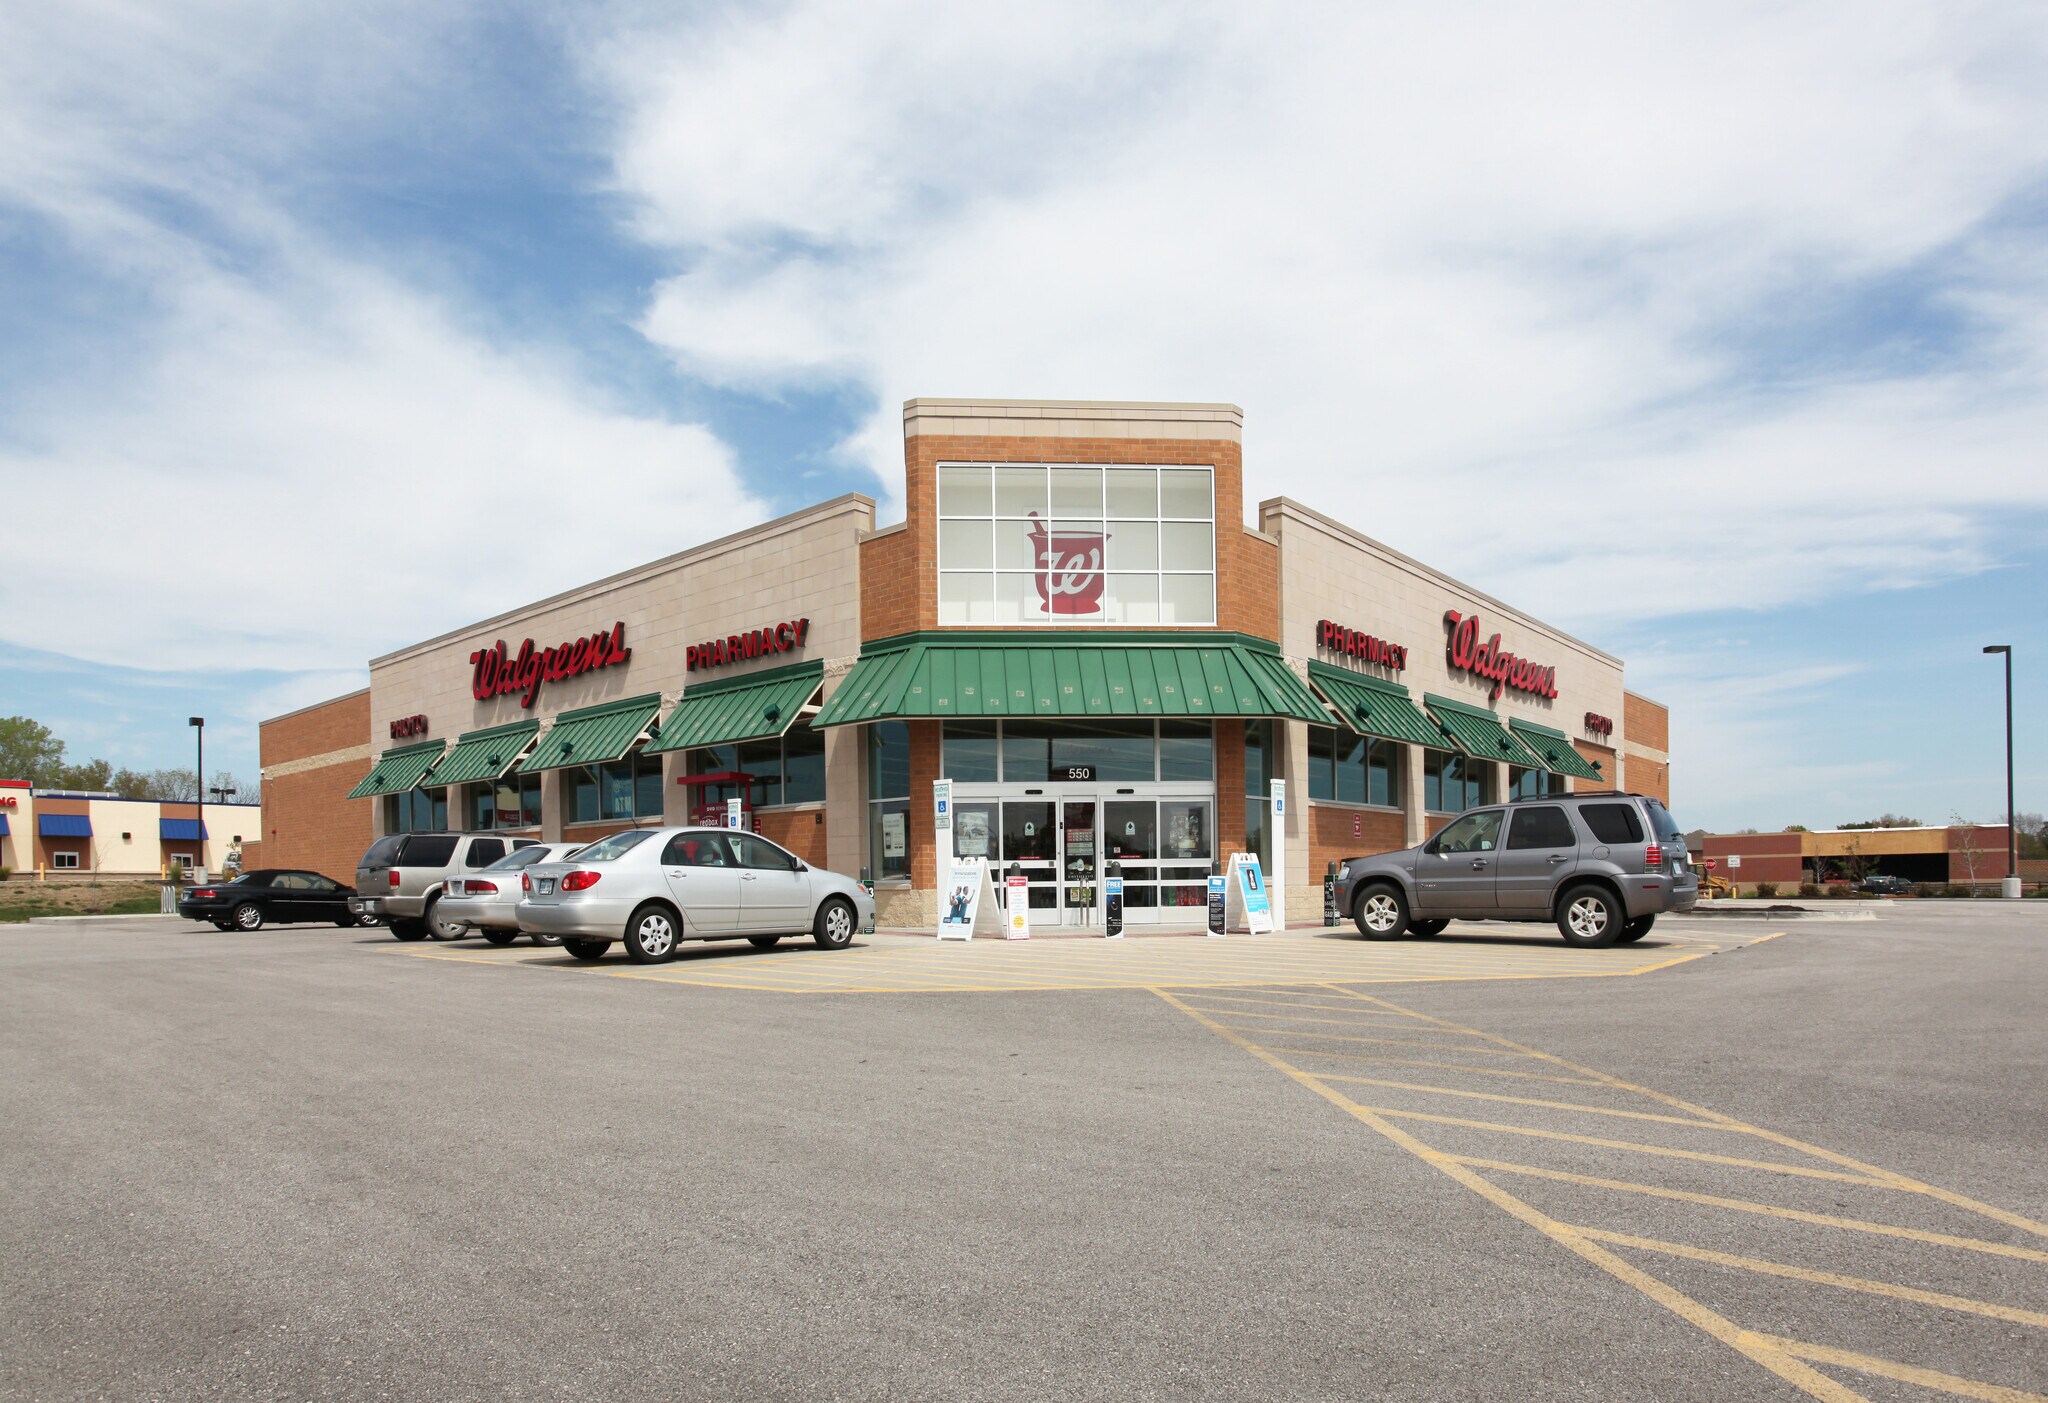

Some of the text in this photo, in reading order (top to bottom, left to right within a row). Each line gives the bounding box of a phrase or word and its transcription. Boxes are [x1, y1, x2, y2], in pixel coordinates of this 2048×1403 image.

[686, 618, 810, 672] PHARMACY
[1317, 619, 1408, 671] PHARMACY
[1443, 609, 1558, 700] Walgreens
[470, 621, 632, 709] Walgreens
[390, 714, 428, 739] PHOTO
[1586, 711, 1613, 736] PHOTO
[1068, 768, 1090, 779] 550
[615, 796, 632, 813] ATM
[700, 816, 719, 827] redbox
[1106, 880, 1122, 888] FREE
